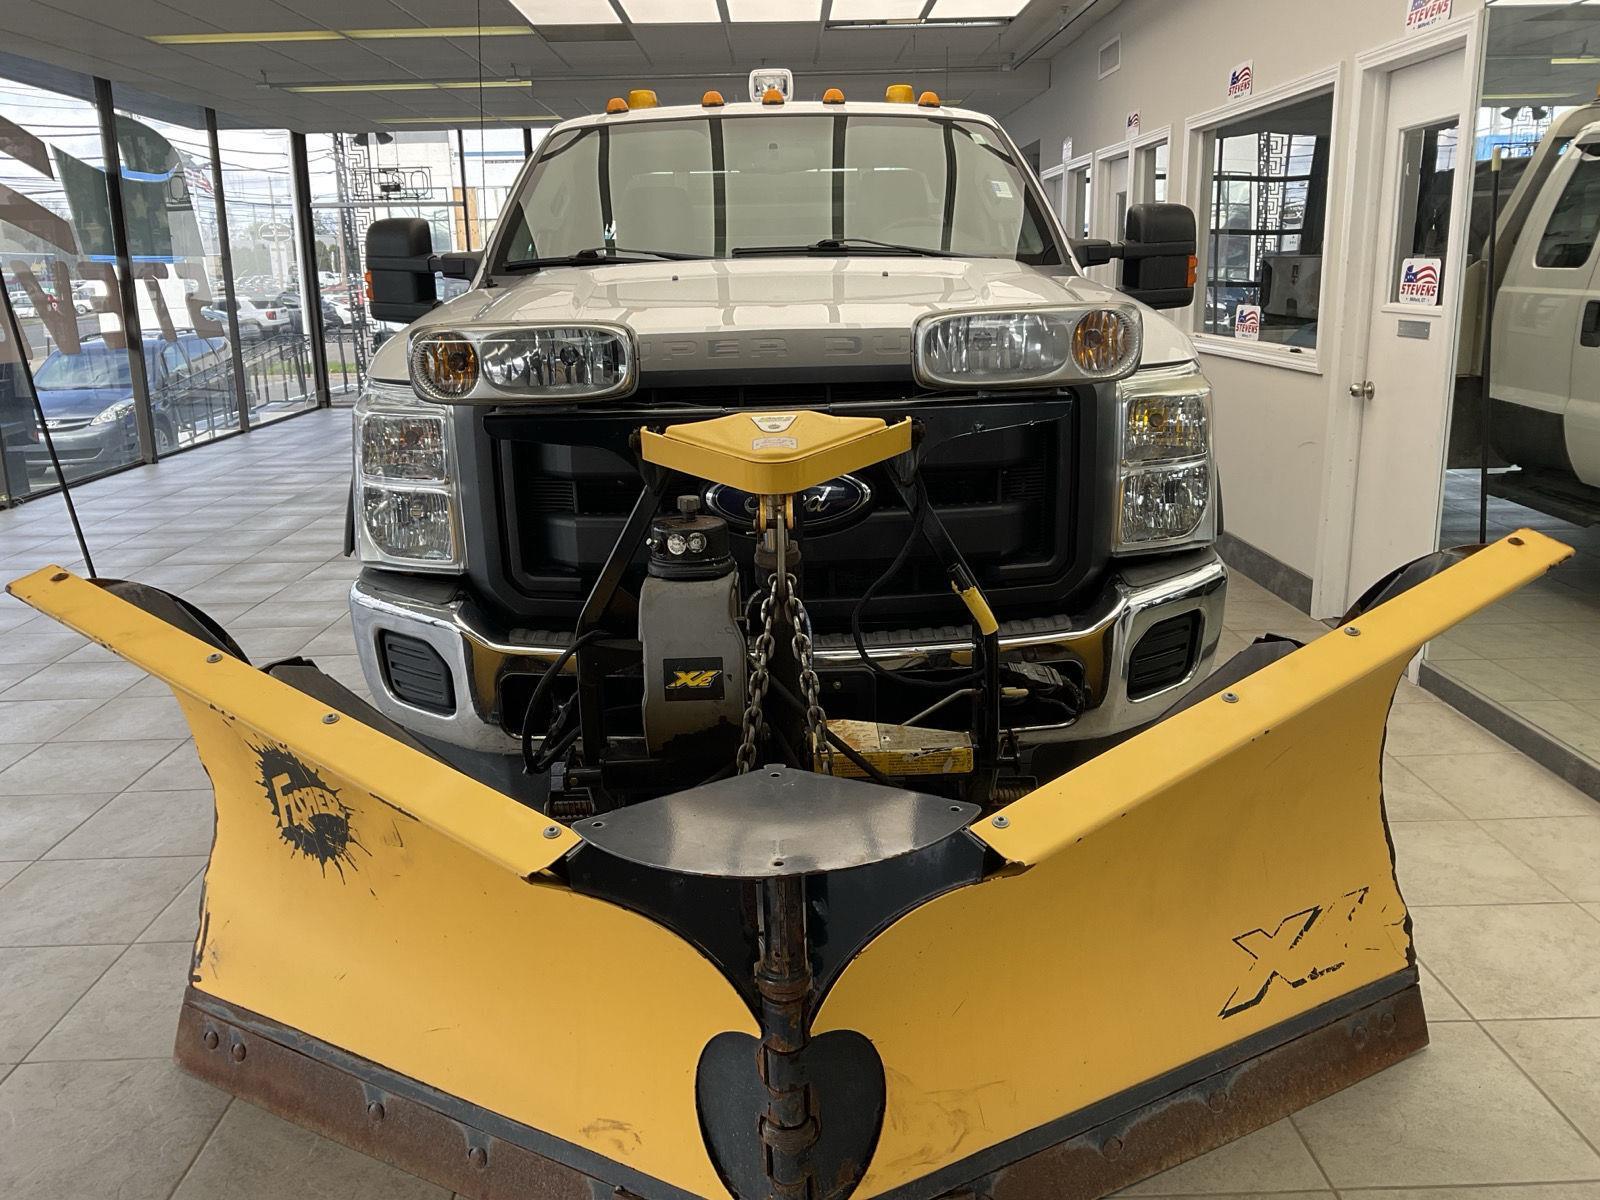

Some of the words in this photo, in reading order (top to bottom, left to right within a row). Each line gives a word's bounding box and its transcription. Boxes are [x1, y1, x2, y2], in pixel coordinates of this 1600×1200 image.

[1406, 0, 1449, 26] STEVENS
[1228, 80, 1251, 96] STEVENS
[1400, 283, 1437, 297] STEVENS
[1235, 324, 1259, 334] STEVENS
[271, 772, 346, 831] FISHER
